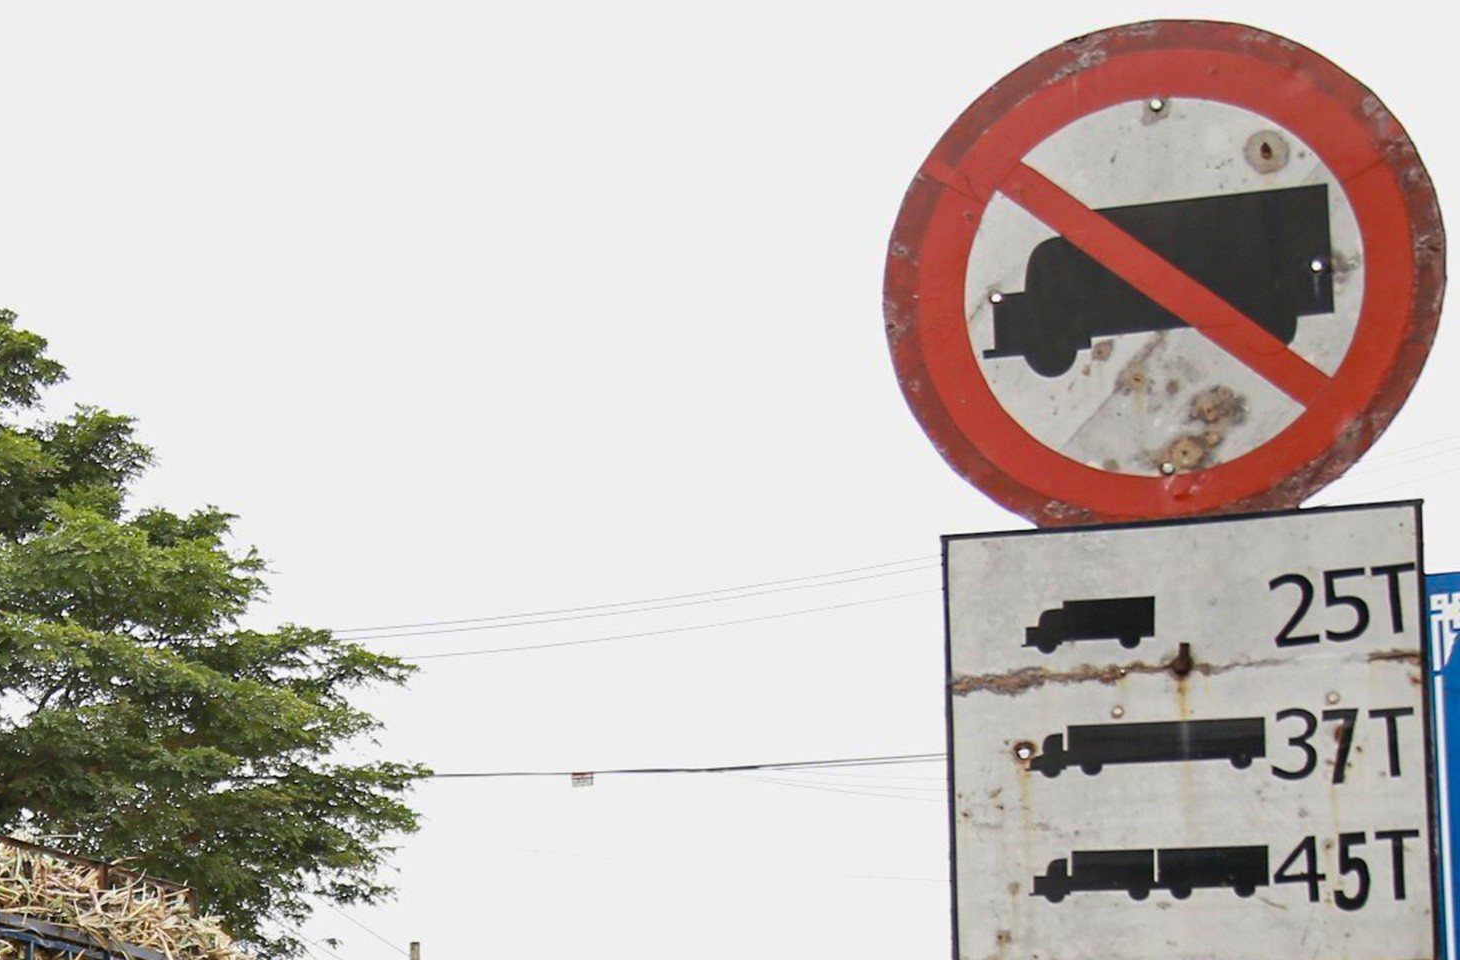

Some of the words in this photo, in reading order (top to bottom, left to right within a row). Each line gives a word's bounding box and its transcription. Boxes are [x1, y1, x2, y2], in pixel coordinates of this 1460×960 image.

[1269, 562, 1415, 648] 25T
[1271, 706, 1414, 784] 37T
[1273, 829, 1420, 911] 45T
